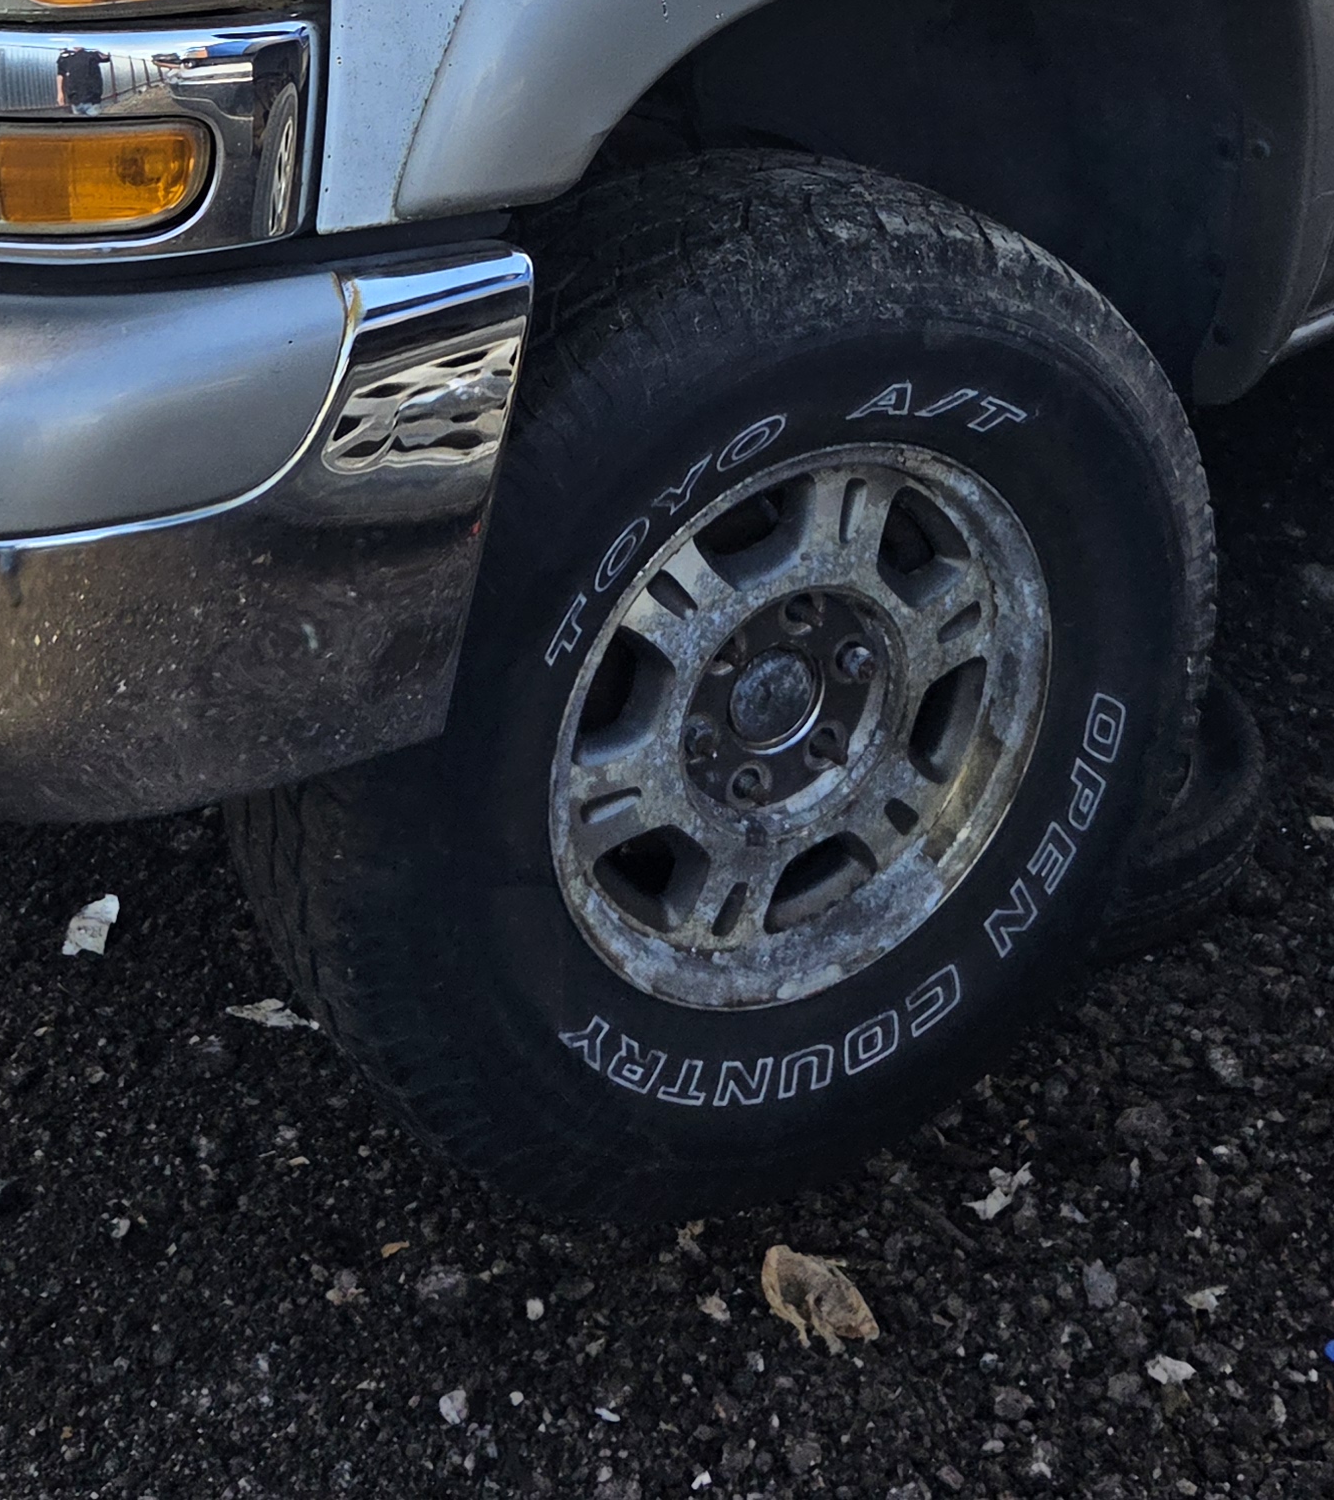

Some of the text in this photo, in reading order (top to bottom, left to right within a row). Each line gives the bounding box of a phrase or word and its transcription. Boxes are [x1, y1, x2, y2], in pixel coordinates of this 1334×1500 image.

[545, 382, 1028, 667] TOYO A/T
[560, 693, 1127, 1107] OPEN COUNTRY
